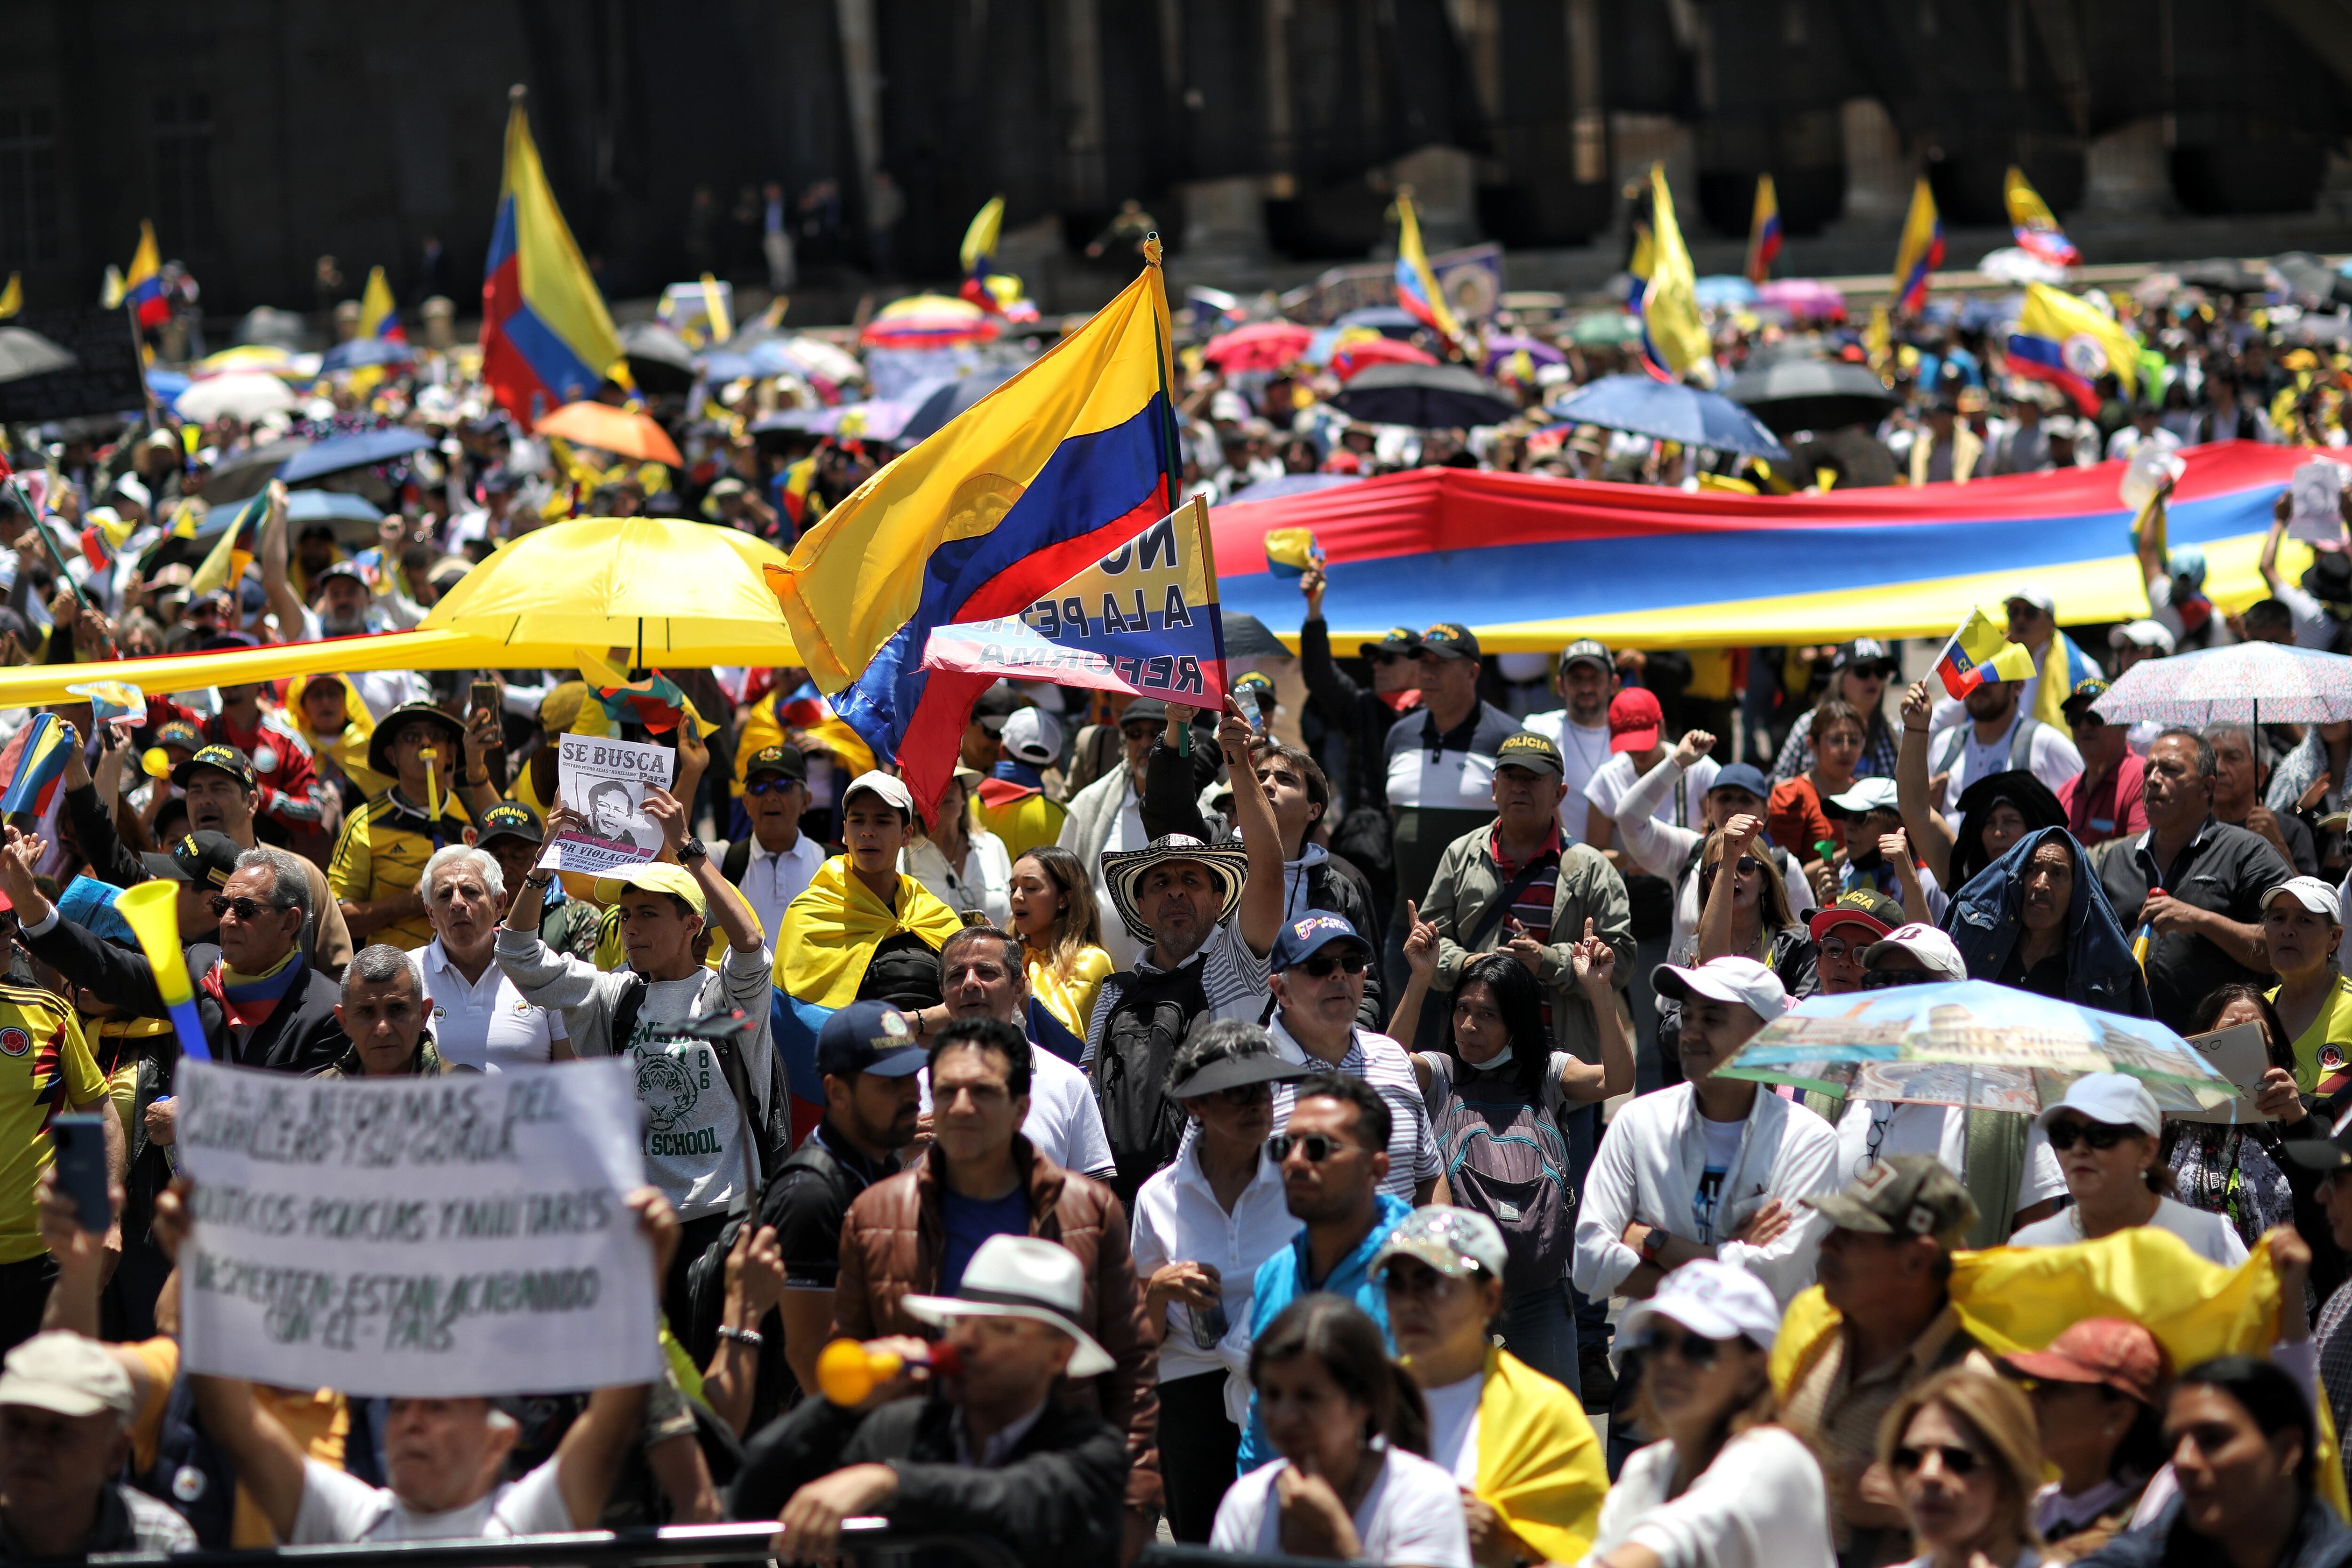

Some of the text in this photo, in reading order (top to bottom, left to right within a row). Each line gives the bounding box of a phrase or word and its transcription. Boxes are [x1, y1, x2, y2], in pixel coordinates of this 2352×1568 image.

[1501, 736, 1550, 753] POLICIA
[563, 742, 665, 773] SE BUSCA
[639, 772, 667, 783] Para
[485, 806, 529, 822] VETERANO
[554, 841, 576, 853] POR
[2192, 1039, 2222, 1053] RO
[651, 1127, 723, 1156] SCHOOL
